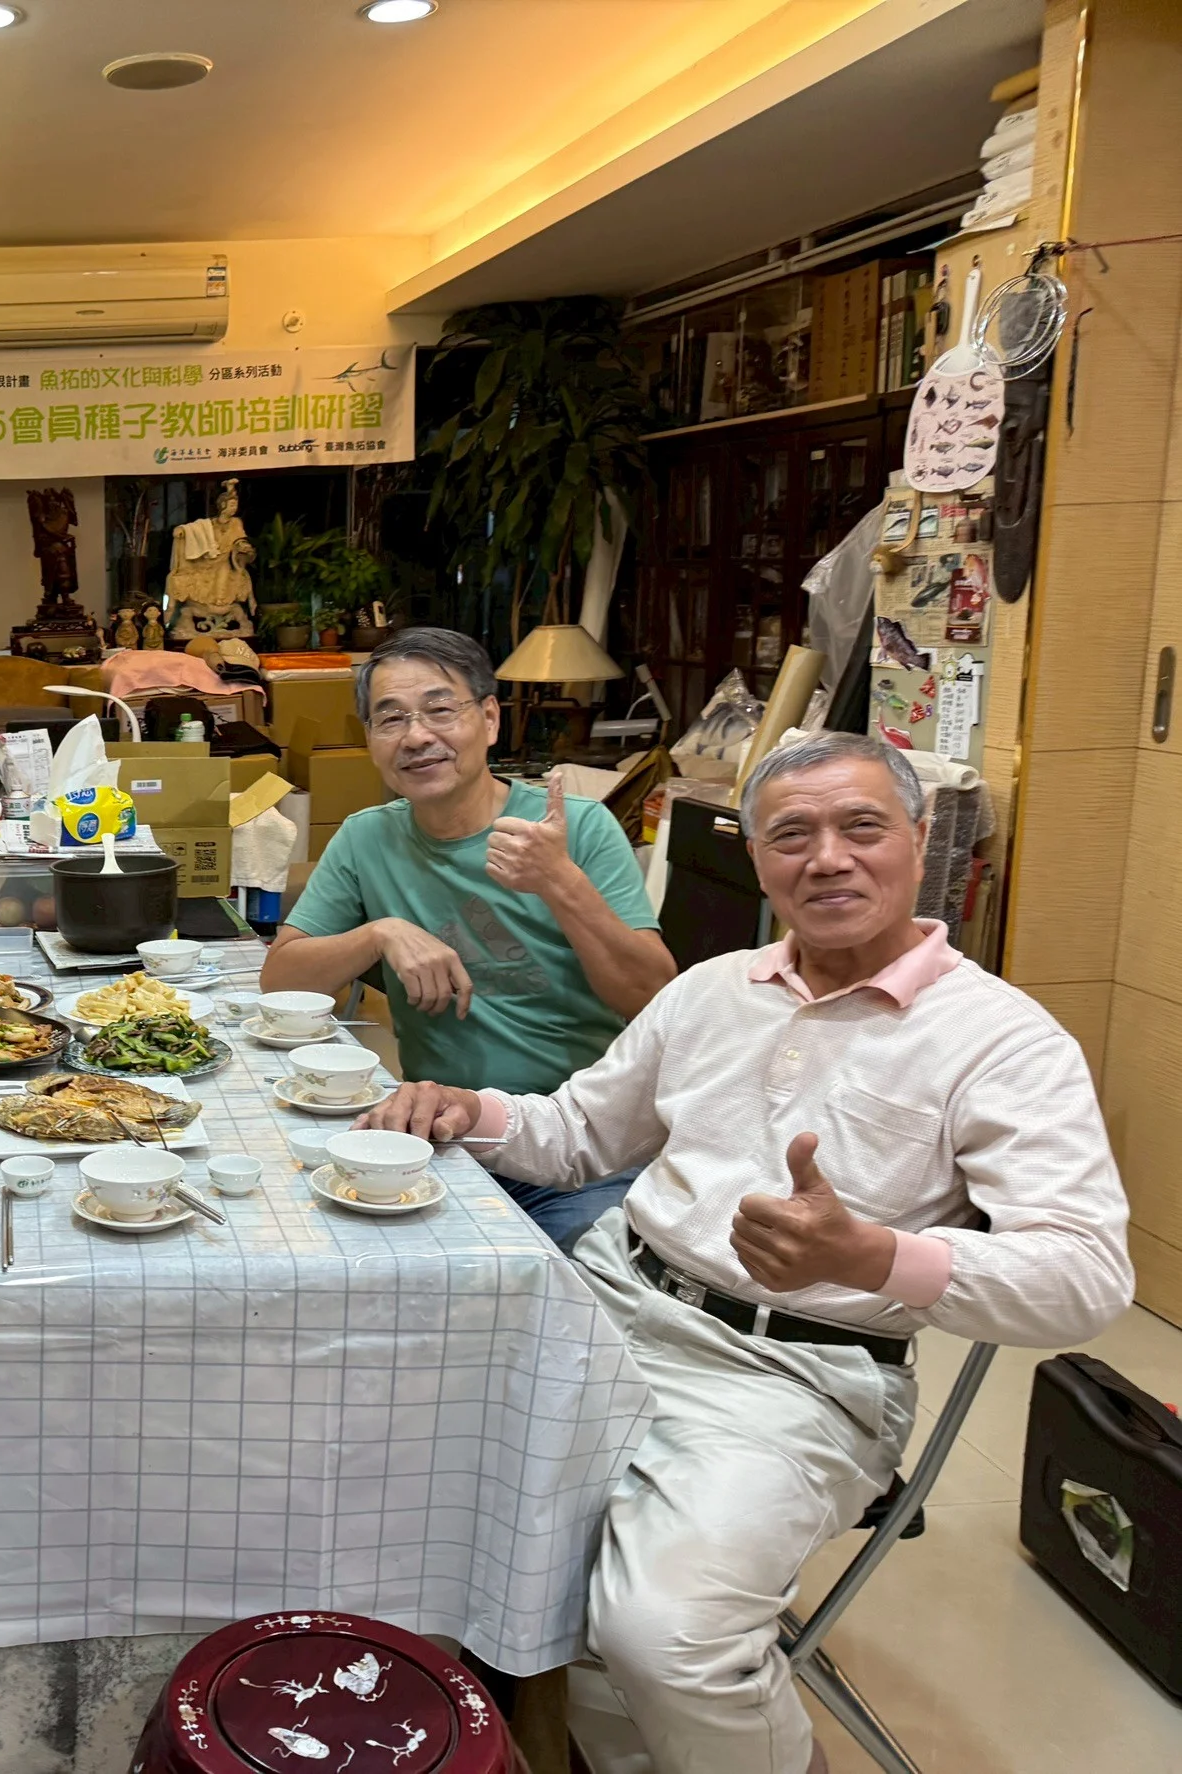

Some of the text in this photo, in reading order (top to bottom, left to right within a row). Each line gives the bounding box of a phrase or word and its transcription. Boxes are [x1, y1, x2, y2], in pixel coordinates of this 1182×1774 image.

[40, 364, 203, 391] 魚拓的文化與科學
[209, 364, 282, 381] 分區系列活動
[217, 445, 268, 458] 海洋委員會
